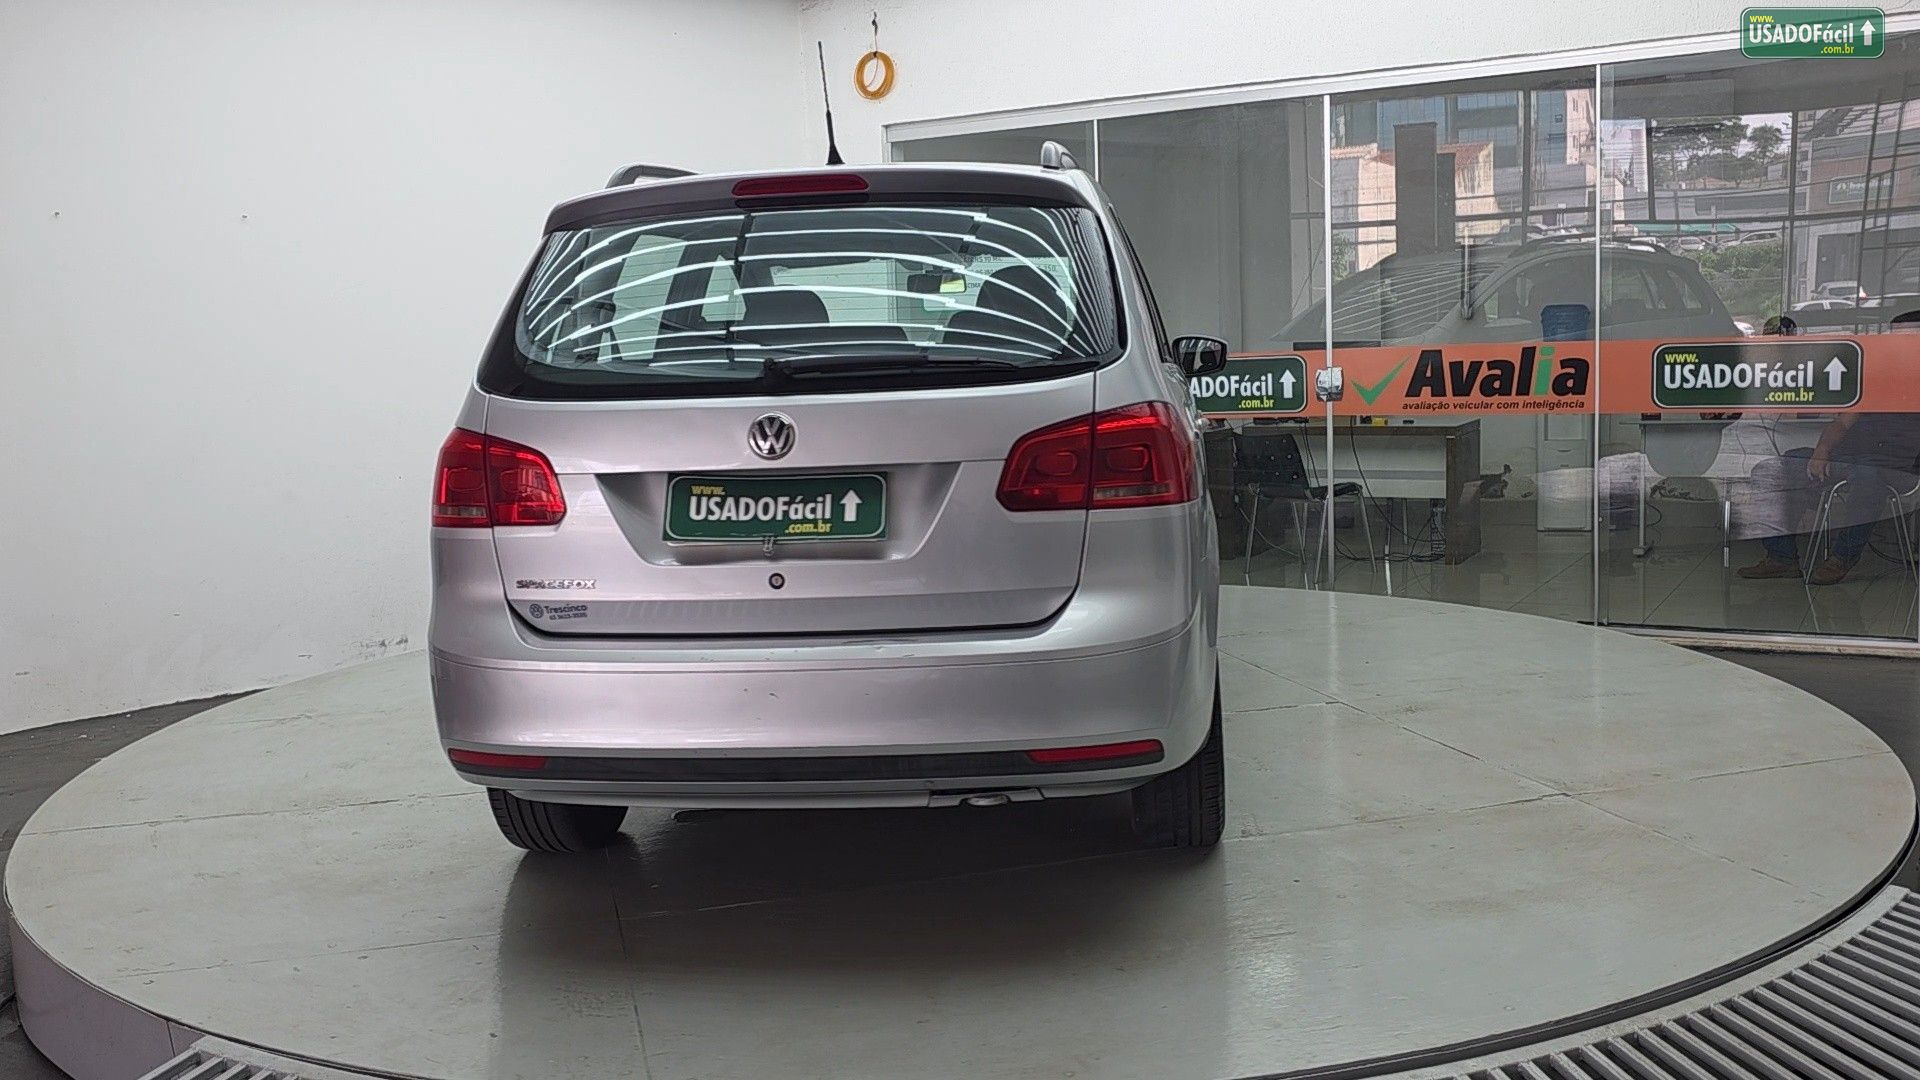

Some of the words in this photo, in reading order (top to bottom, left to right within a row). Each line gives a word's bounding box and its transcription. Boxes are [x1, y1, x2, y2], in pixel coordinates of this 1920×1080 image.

[1665, 353, 1699, 363] www.
[1405, 346, 1590, 398] Avalia
[1664, 360, 1814, 389] USADOFácil
[1189, 373, 1273, 398] ADOFácil
[1238, 396, 1275, 408] .com.br
[1764, 388, 1815, 402] .com.br
[1402, 401, 1450, 411] avaliação
[1452, 401, 1494, 410] veicular
[1497, 401, 1519, 409] com
[1522, 400, 1585, 411] inteligência
[691, 486, 725, 495] www.
[689, 493, 832, 521] USADOFácil
[785, 520, 832, 534] .com.br
[516, 579, 597, 590] SPACEFOX
